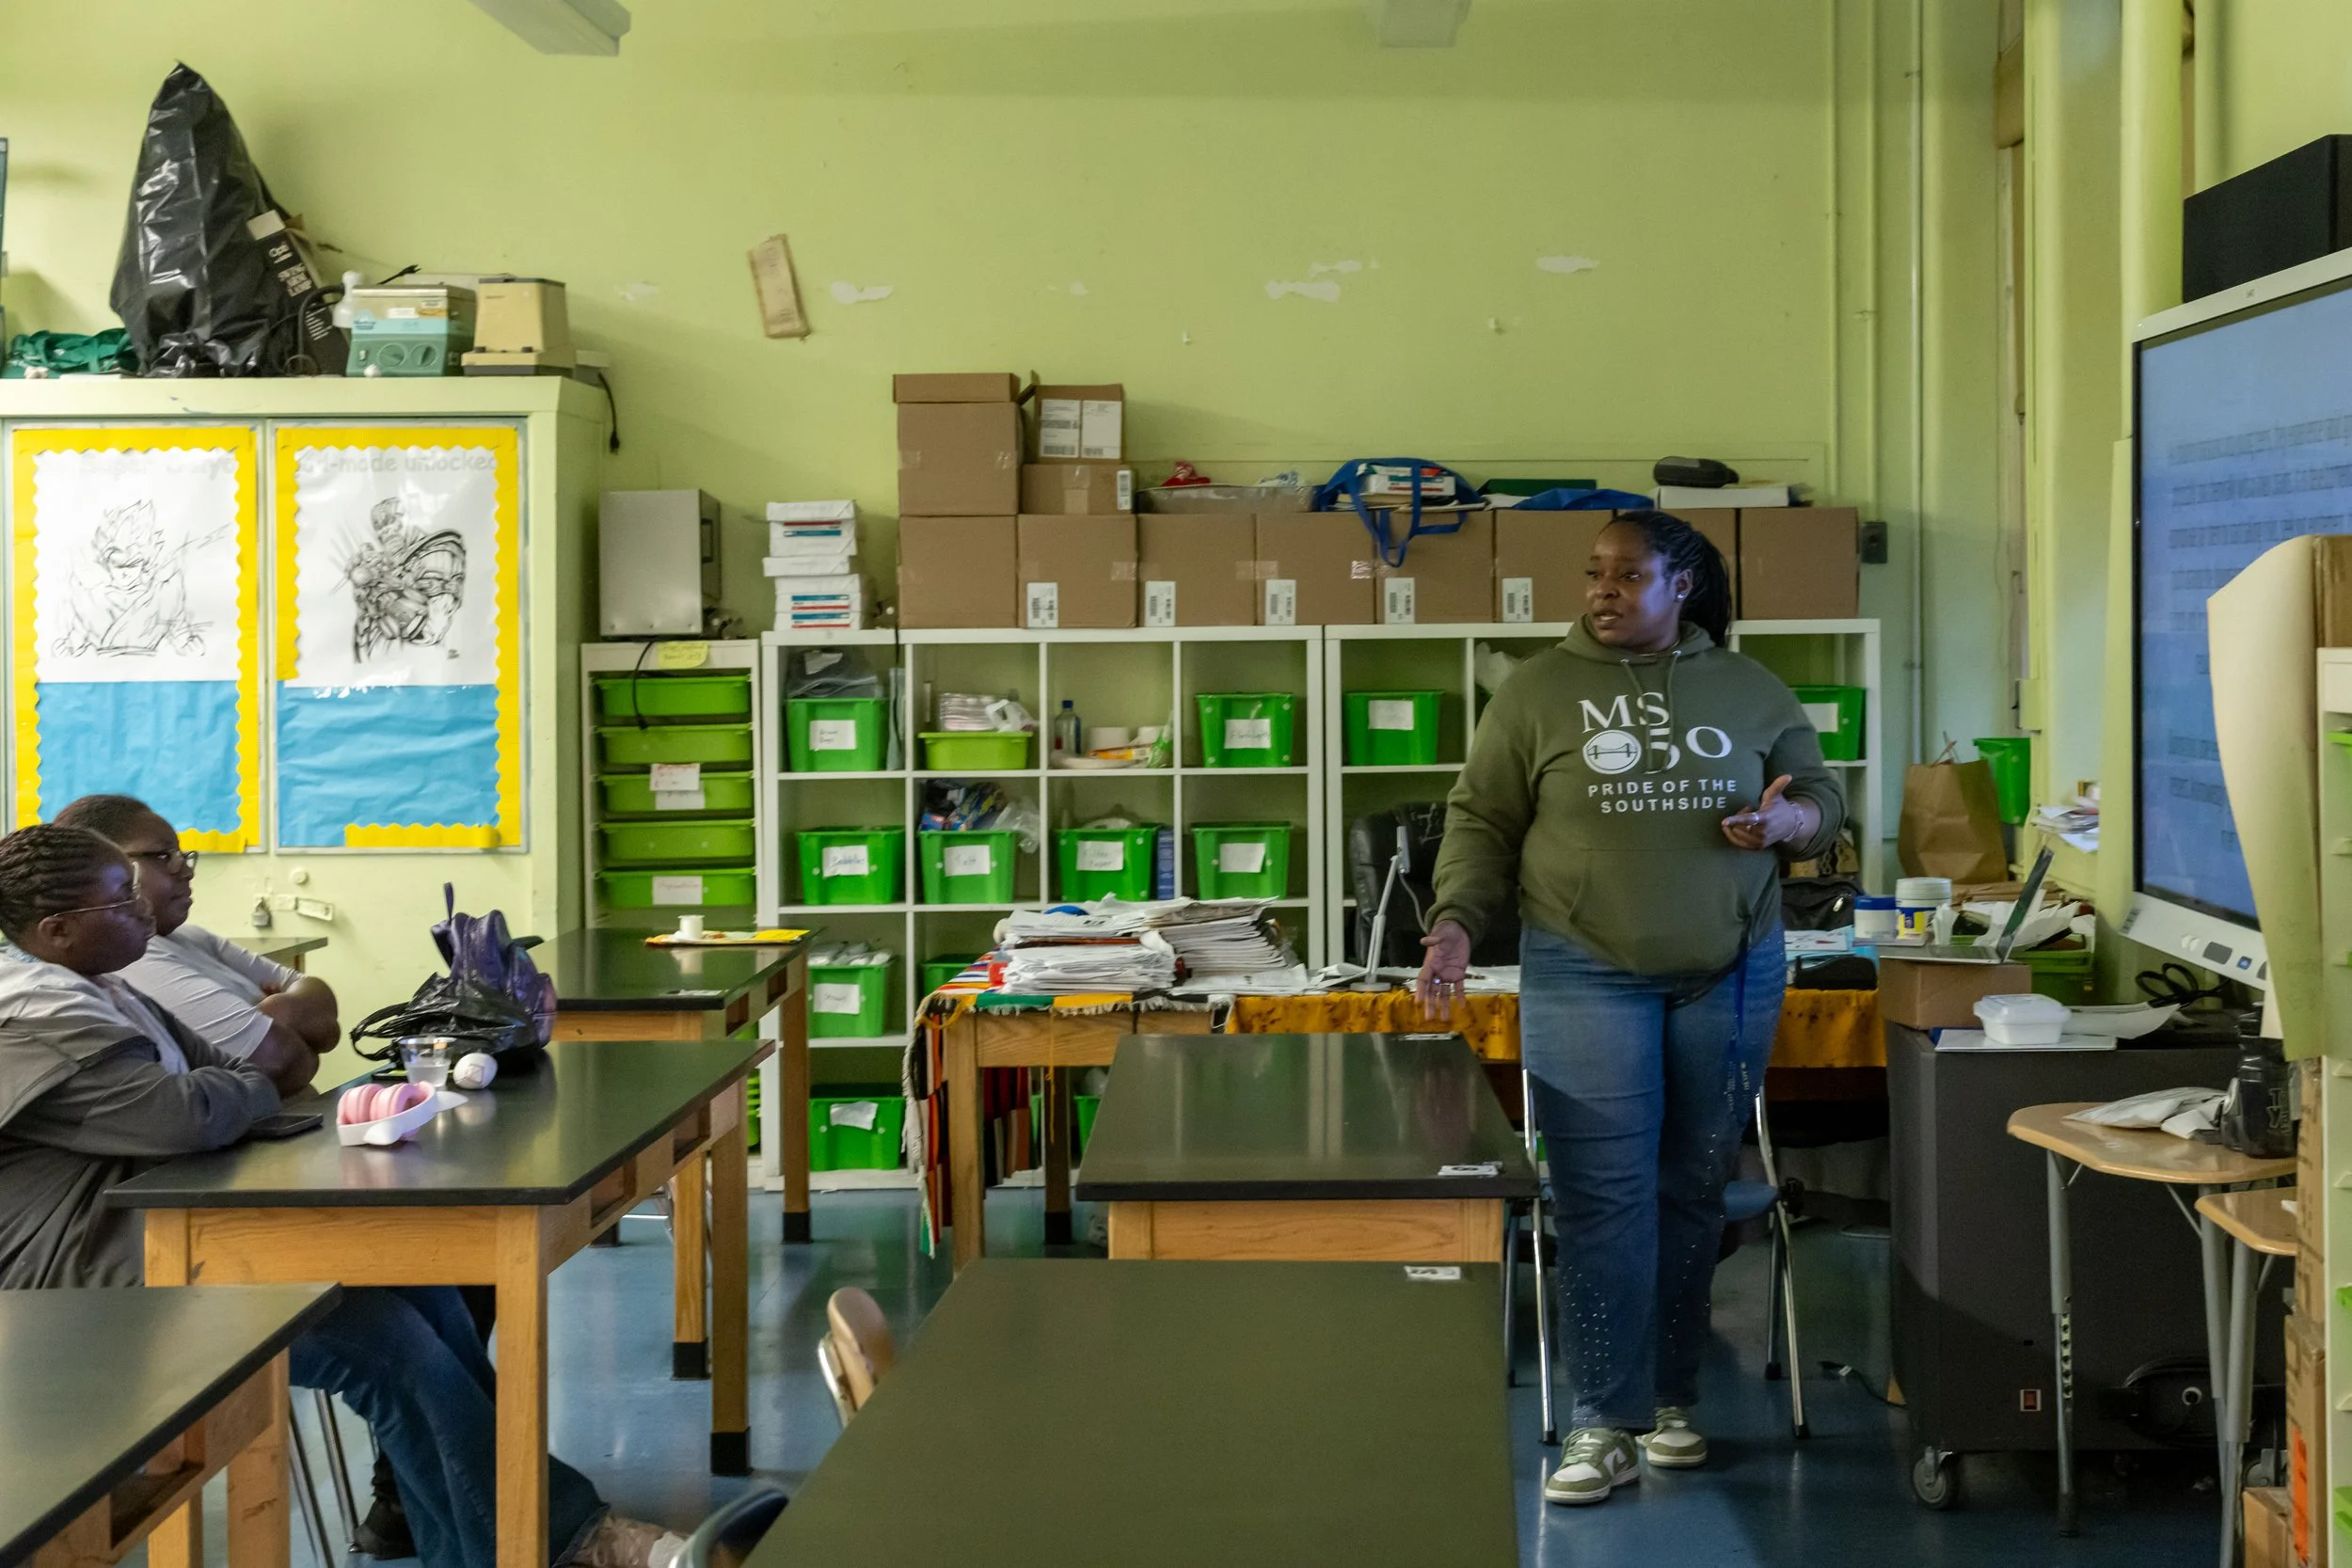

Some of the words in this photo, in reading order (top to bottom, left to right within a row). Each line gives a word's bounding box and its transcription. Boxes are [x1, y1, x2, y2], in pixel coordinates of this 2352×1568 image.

[1578, 692, 1670, 733] MS
[1588, 782, 1654, 798] PRIDE
[1661, 780, 1690, 794] OF
[1698, 779, 1737, 792] THE
[1600, 797, 1727, 814] SOUTHSIDE
